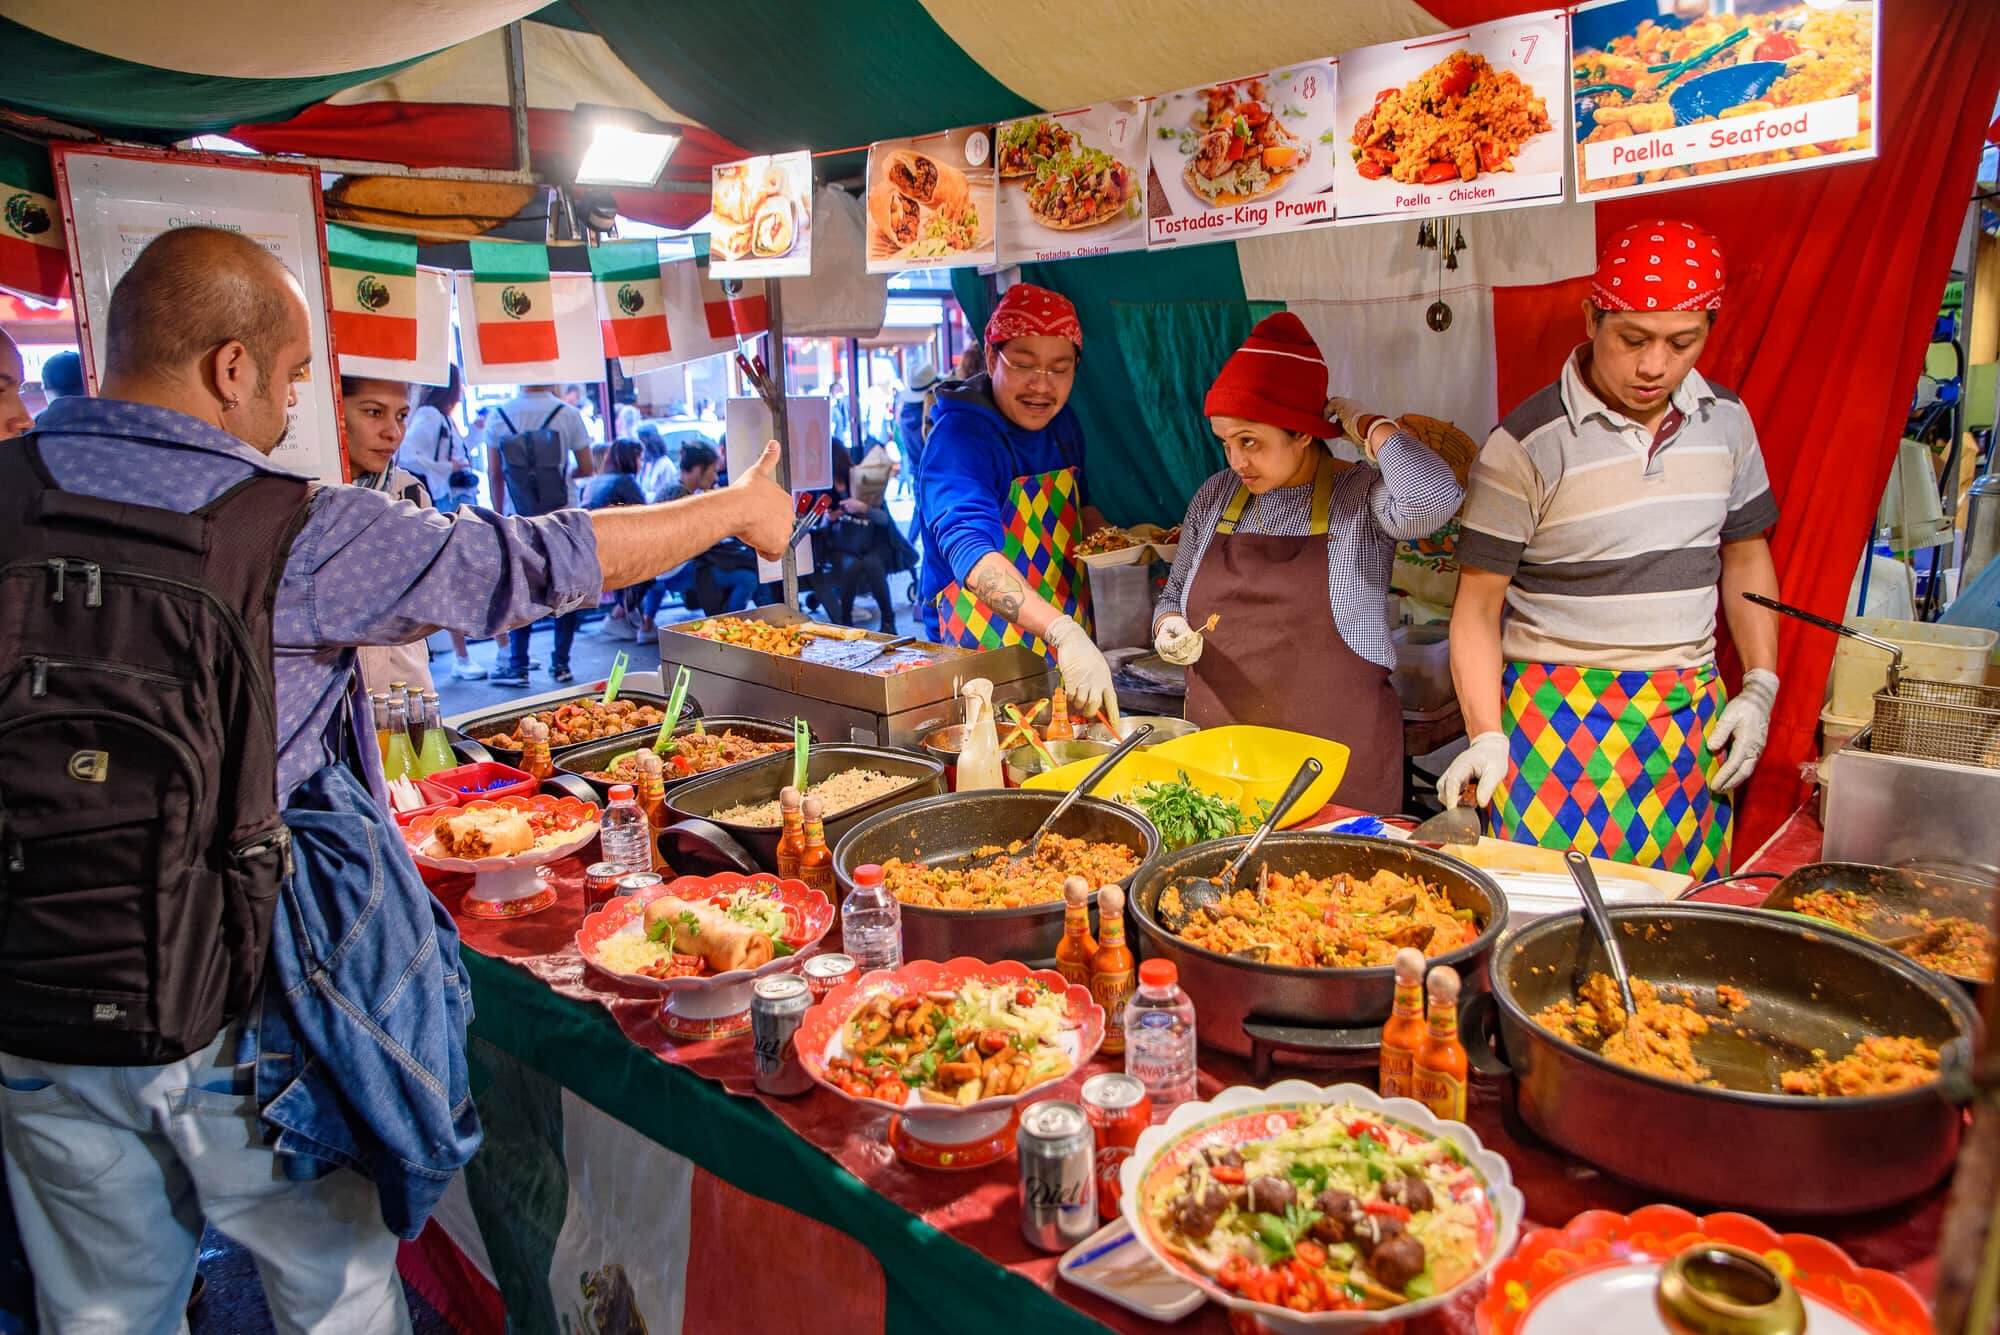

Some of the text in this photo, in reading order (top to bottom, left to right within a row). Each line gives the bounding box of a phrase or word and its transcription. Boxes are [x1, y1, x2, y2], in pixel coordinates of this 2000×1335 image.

[1612, 138, 1674, 165] Paella
[1709, 112, 1808, 149] Seafood
[1395, 192, 1431, 208] Paella
[1449, 186, 1495, 202] Chicken
[1275, 199, 1327, 218] Prawn
[1035, 249, 1071, 262] Tostadas
[1077, 246, 1109, 257] Chicken
[823, 976, 845, 985] TASTE
